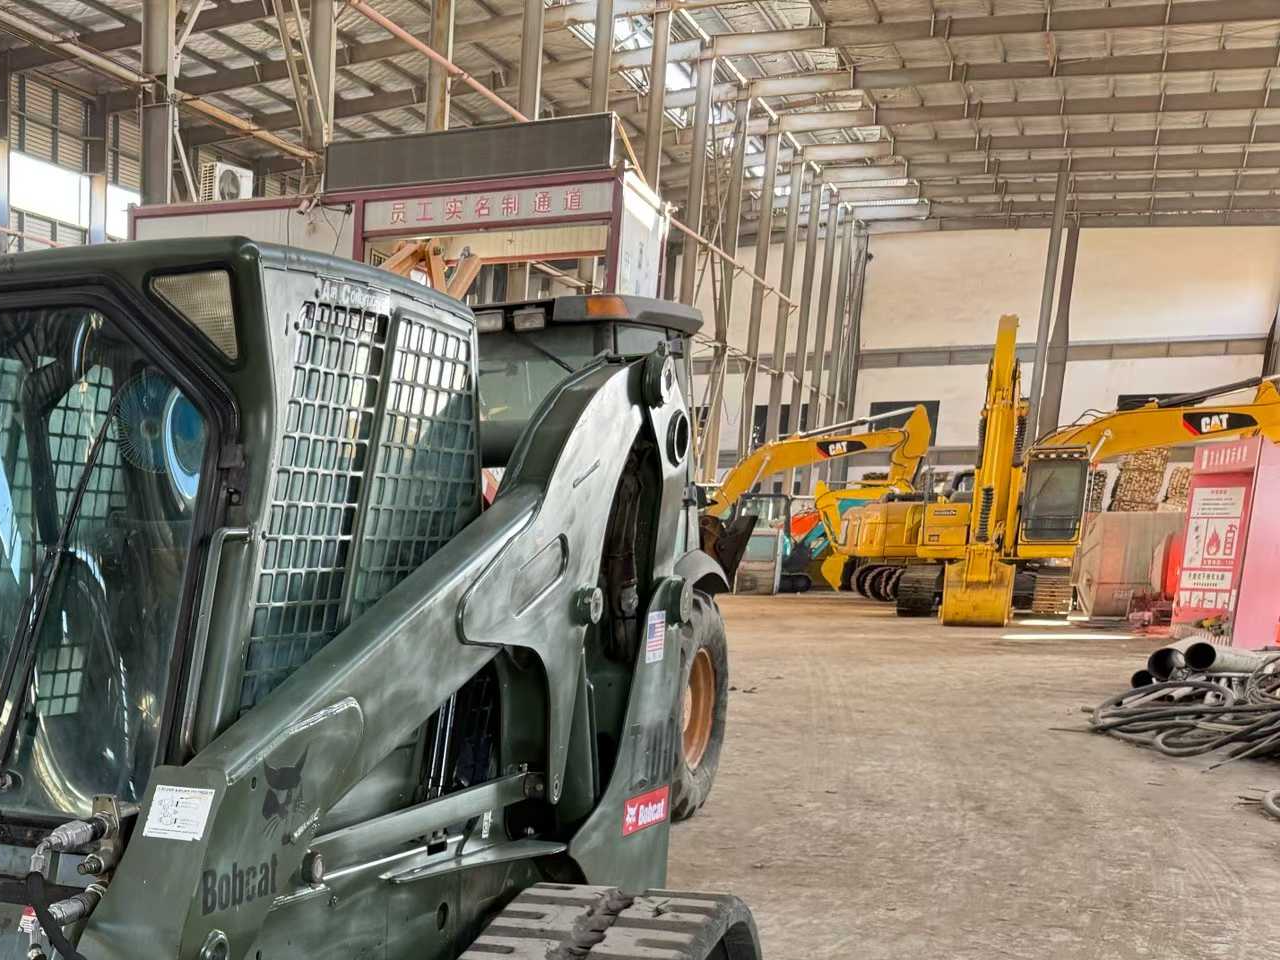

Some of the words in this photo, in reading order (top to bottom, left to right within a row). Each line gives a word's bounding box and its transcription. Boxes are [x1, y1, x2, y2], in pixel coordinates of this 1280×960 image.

[389, 187, 585, 225] 员工实名制通道
[1200, 413, 1229, 433] CAT
[828, 441, 847, 456] CAT
[638, 798, 665, 827] Bobcat
[202, 853, 278, 917] Bobcat
